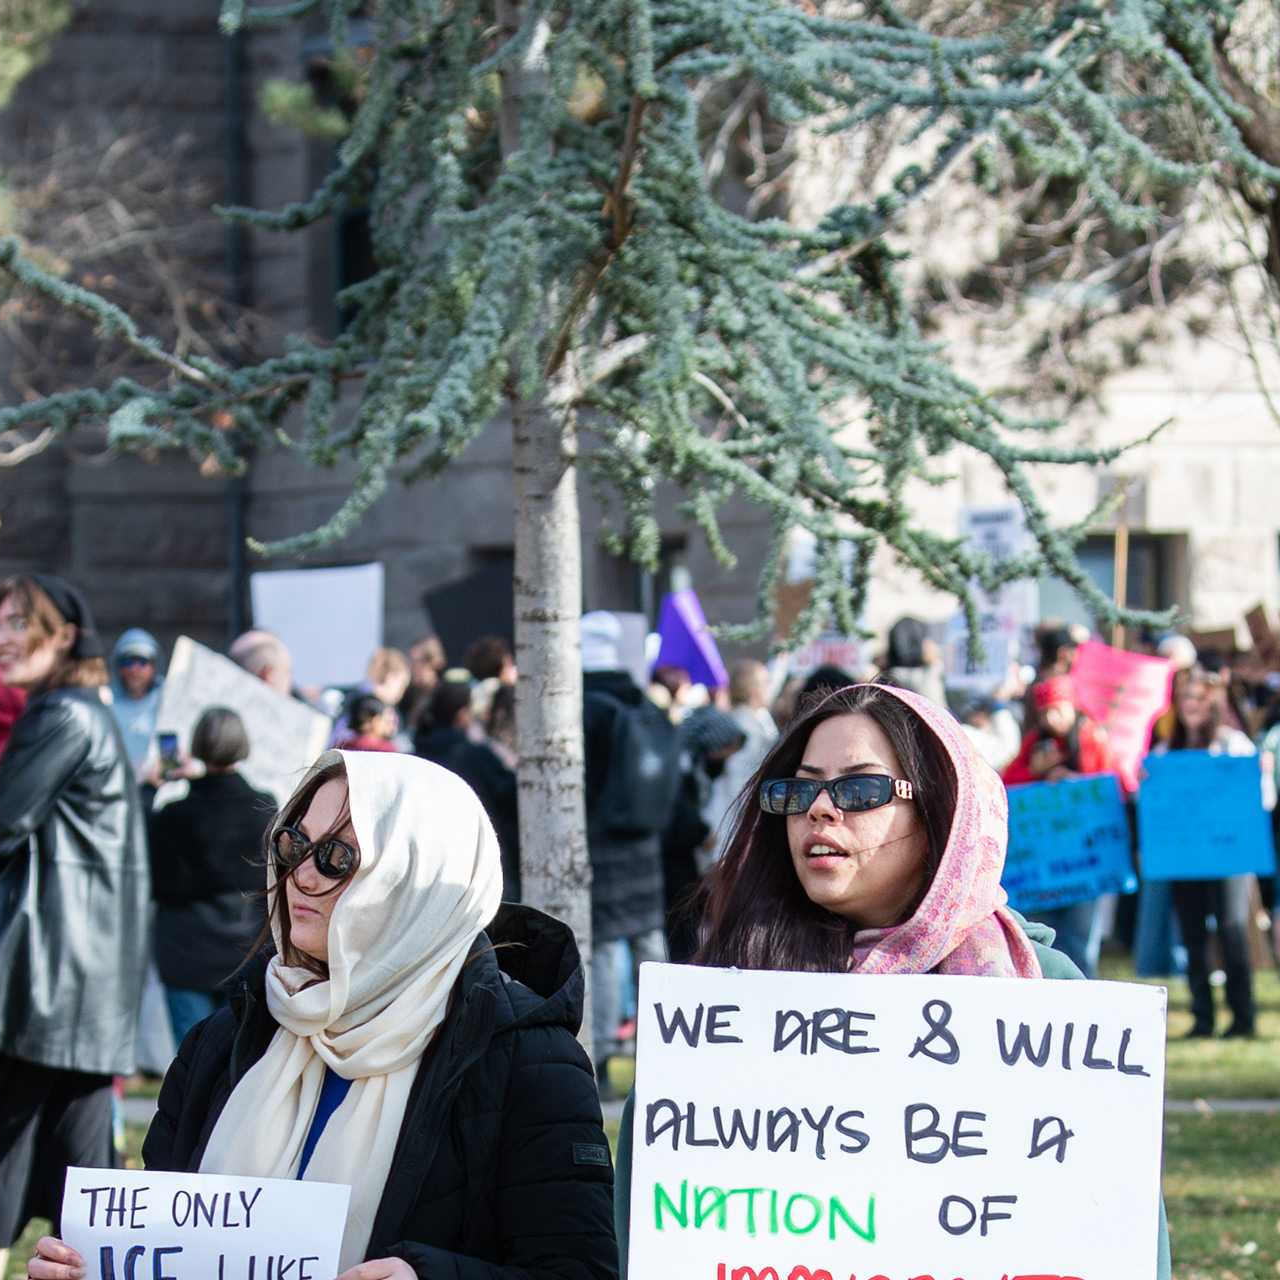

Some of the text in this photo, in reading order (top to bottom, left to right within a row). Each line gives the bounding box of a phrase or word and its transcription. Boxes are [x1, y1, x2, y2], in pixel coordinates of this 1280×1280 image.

[653, 999, 1151, 1077] WE ARE & WILL
[645, 1098, 1075, 1163] ALWAYS BE A
[80, 1187, 263, 1229] THE ONLY
[654, 1179, 1018, 1244] NATION OF
